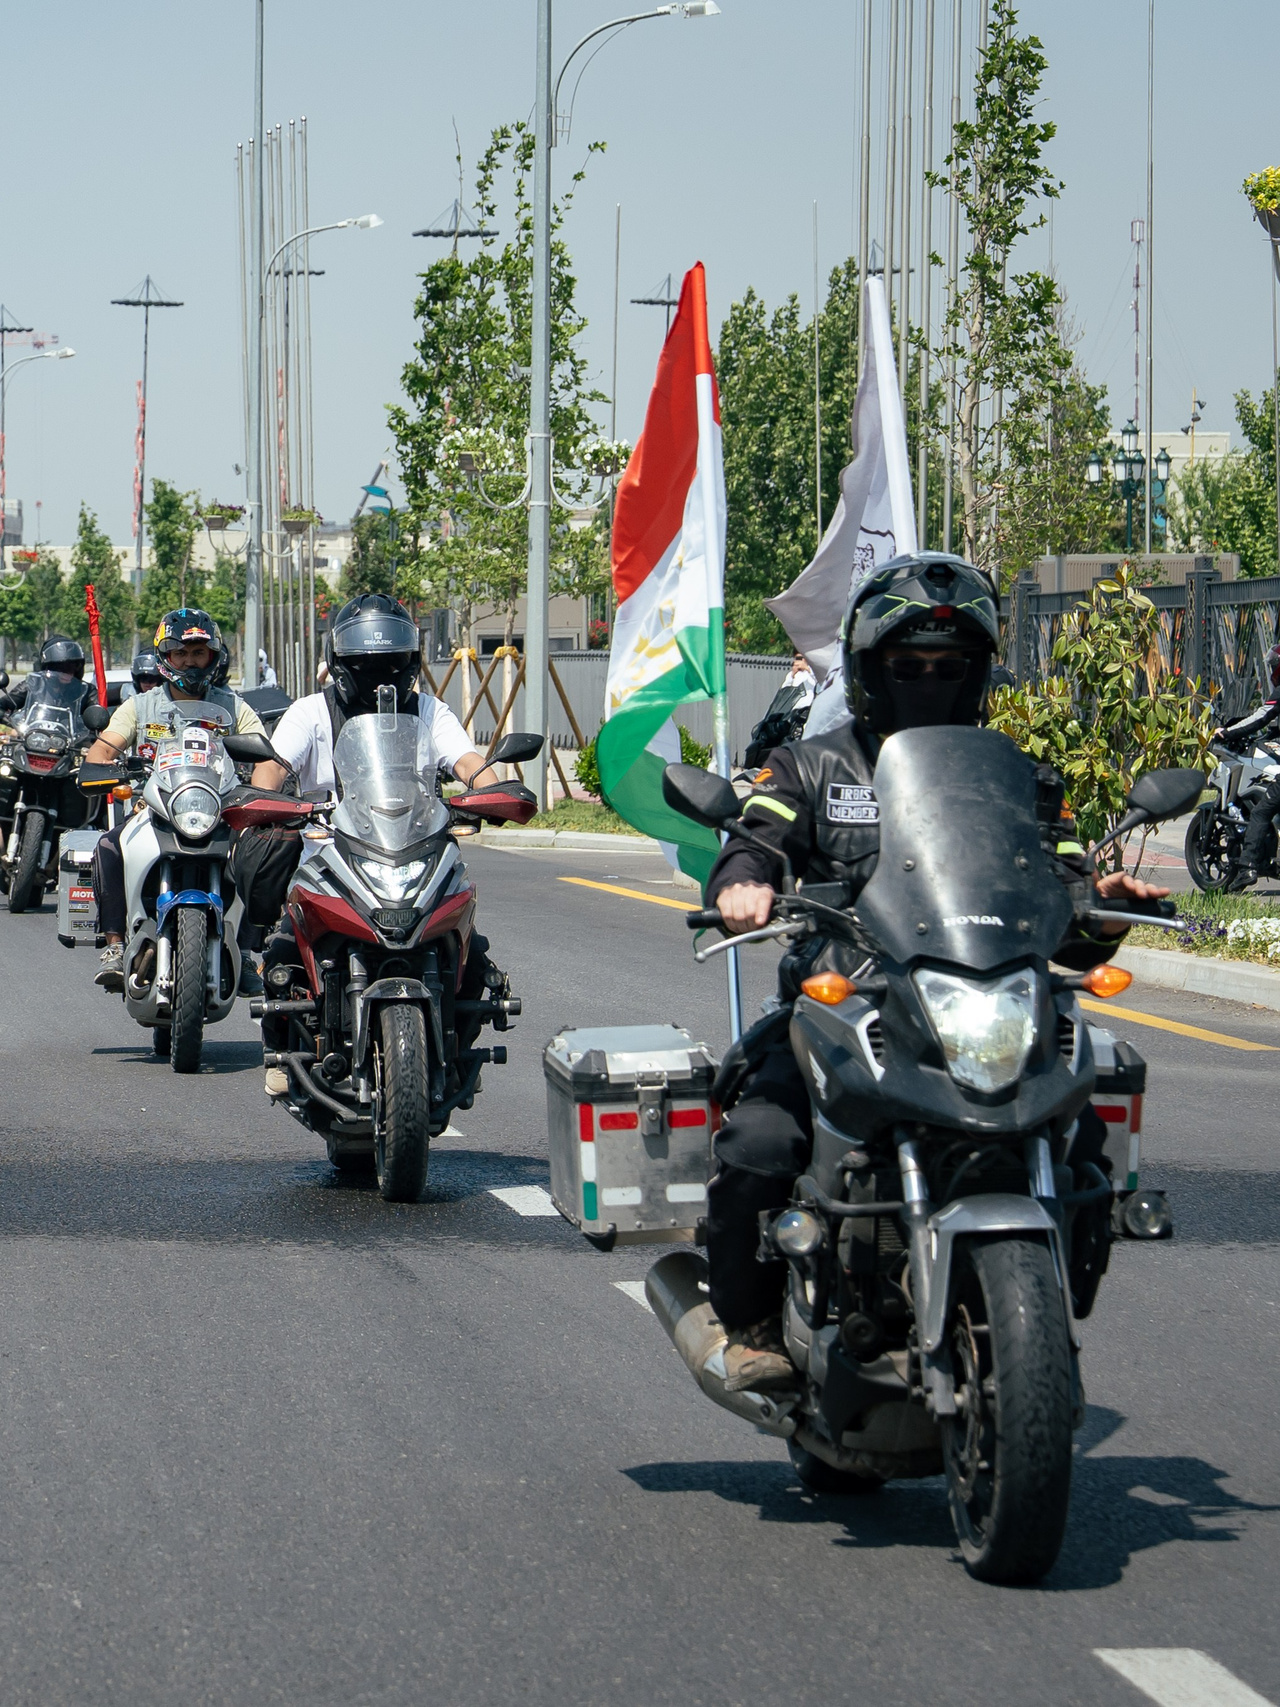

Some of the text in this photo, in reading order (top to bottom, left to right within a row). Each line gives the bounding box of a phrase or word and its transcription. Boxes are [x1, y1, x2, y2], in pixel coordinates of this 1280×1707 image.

[840, 788, 872, 800] IRBIS
[831, 805, 877, 819] MEMBER
[72, 890, 95, 898] MOTU
[942, 915, 1005, 927] HONDA
